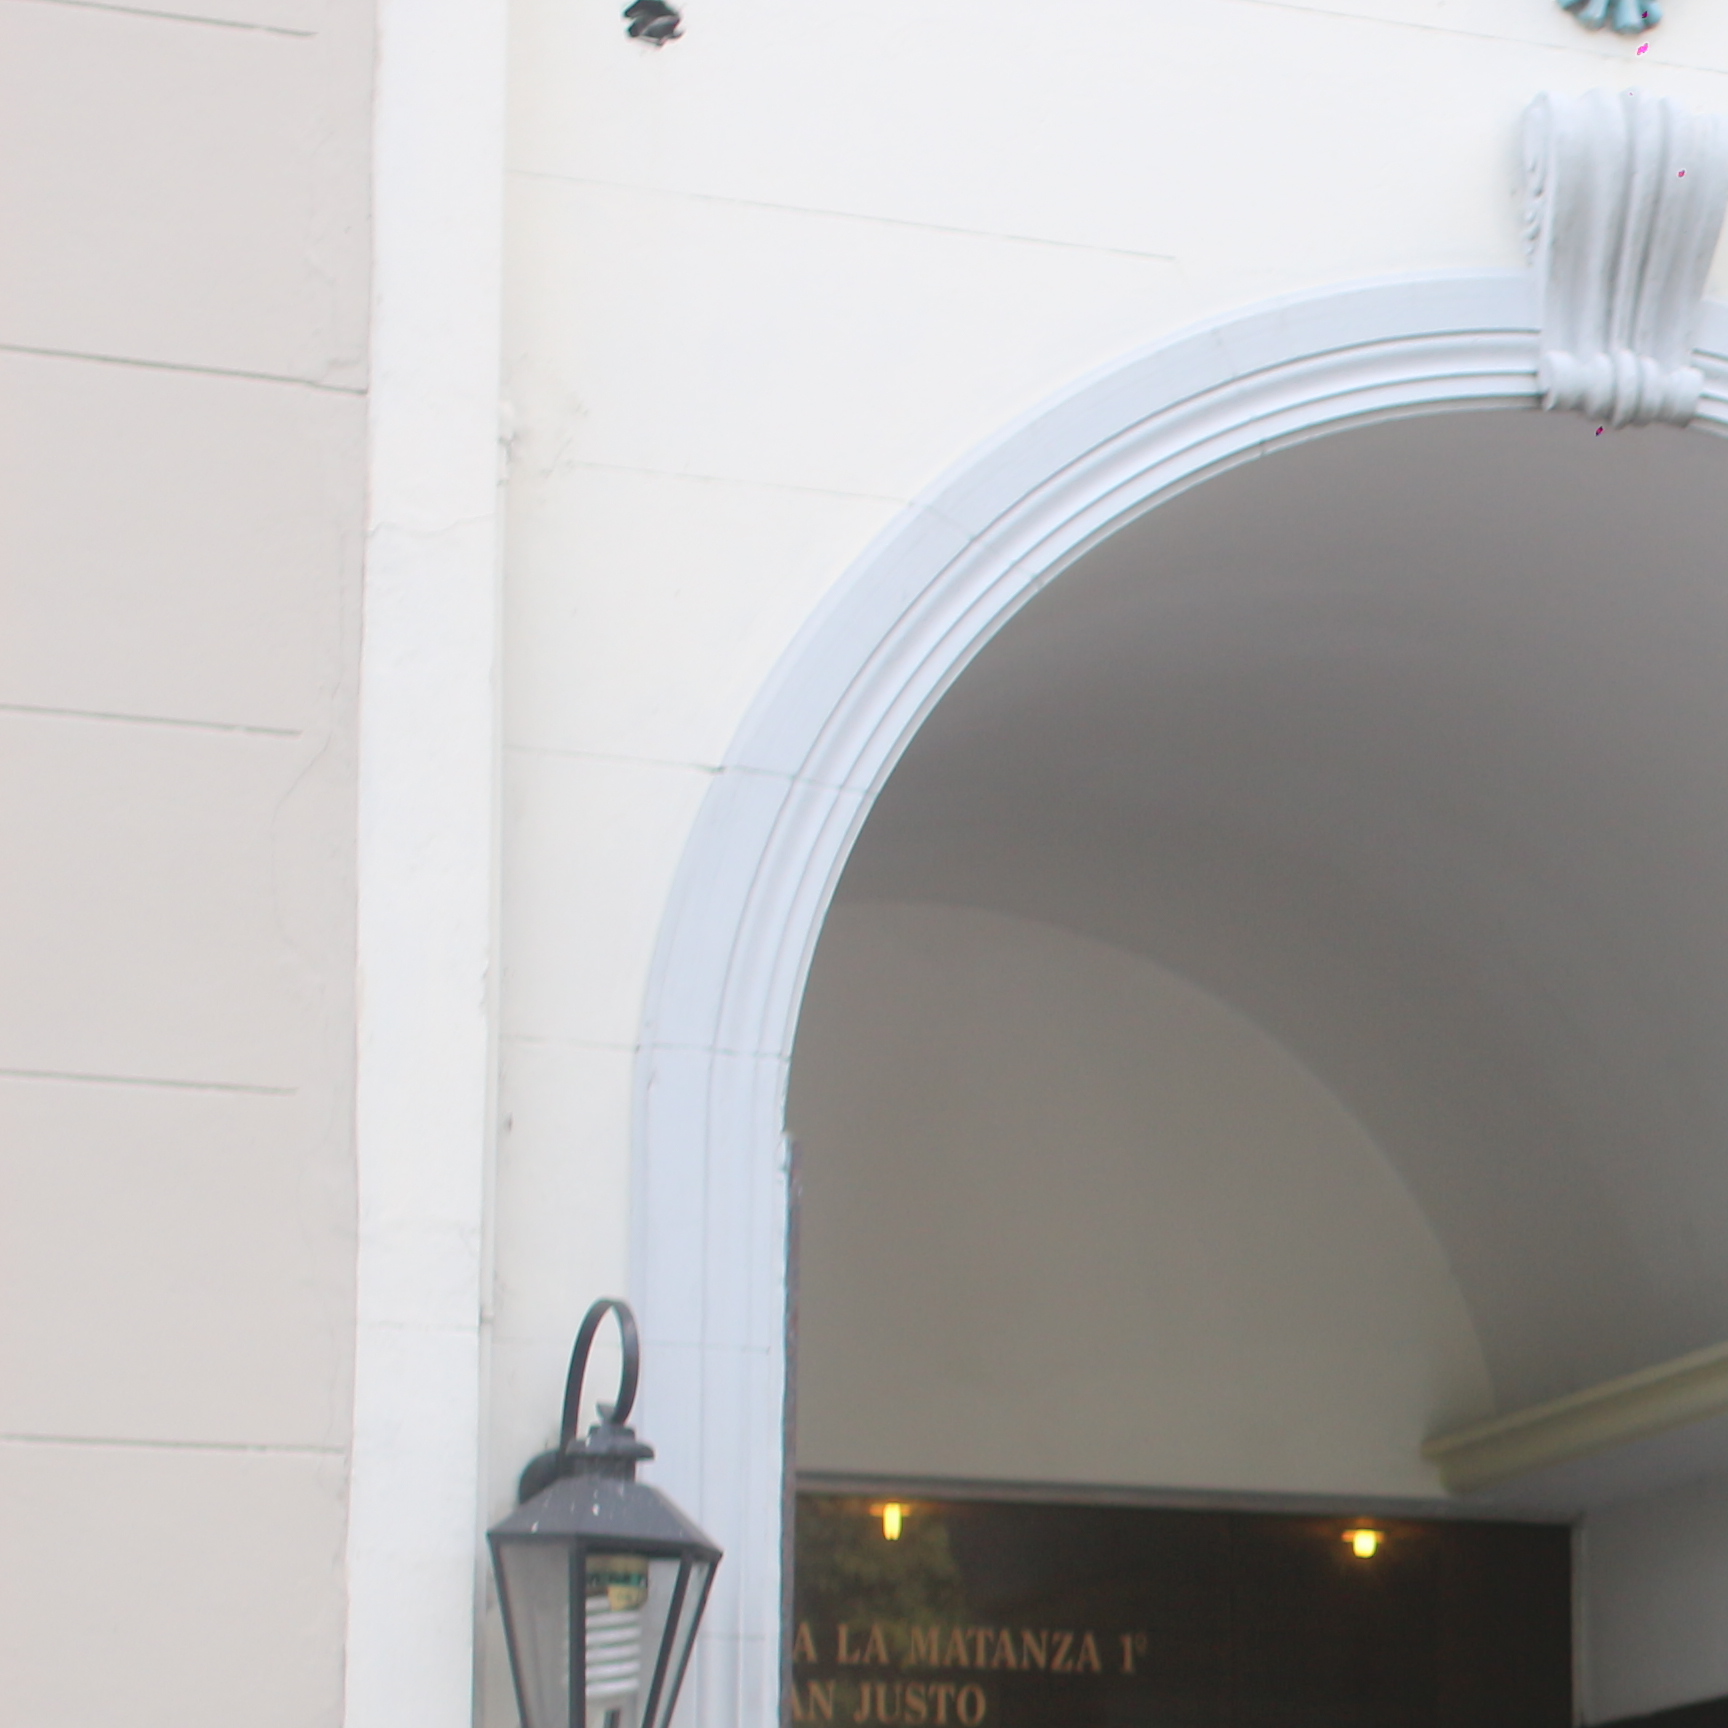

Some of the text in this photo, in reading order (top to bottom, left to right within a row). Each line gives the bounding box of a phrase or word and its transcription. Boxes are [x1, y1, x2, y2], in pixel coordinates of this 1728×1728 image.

[837, 1623, 890, 1665] LA
[908, 1625, 1101, 1672] MATANZA
[792, 1681, 987, 1728] AN JUSTO
